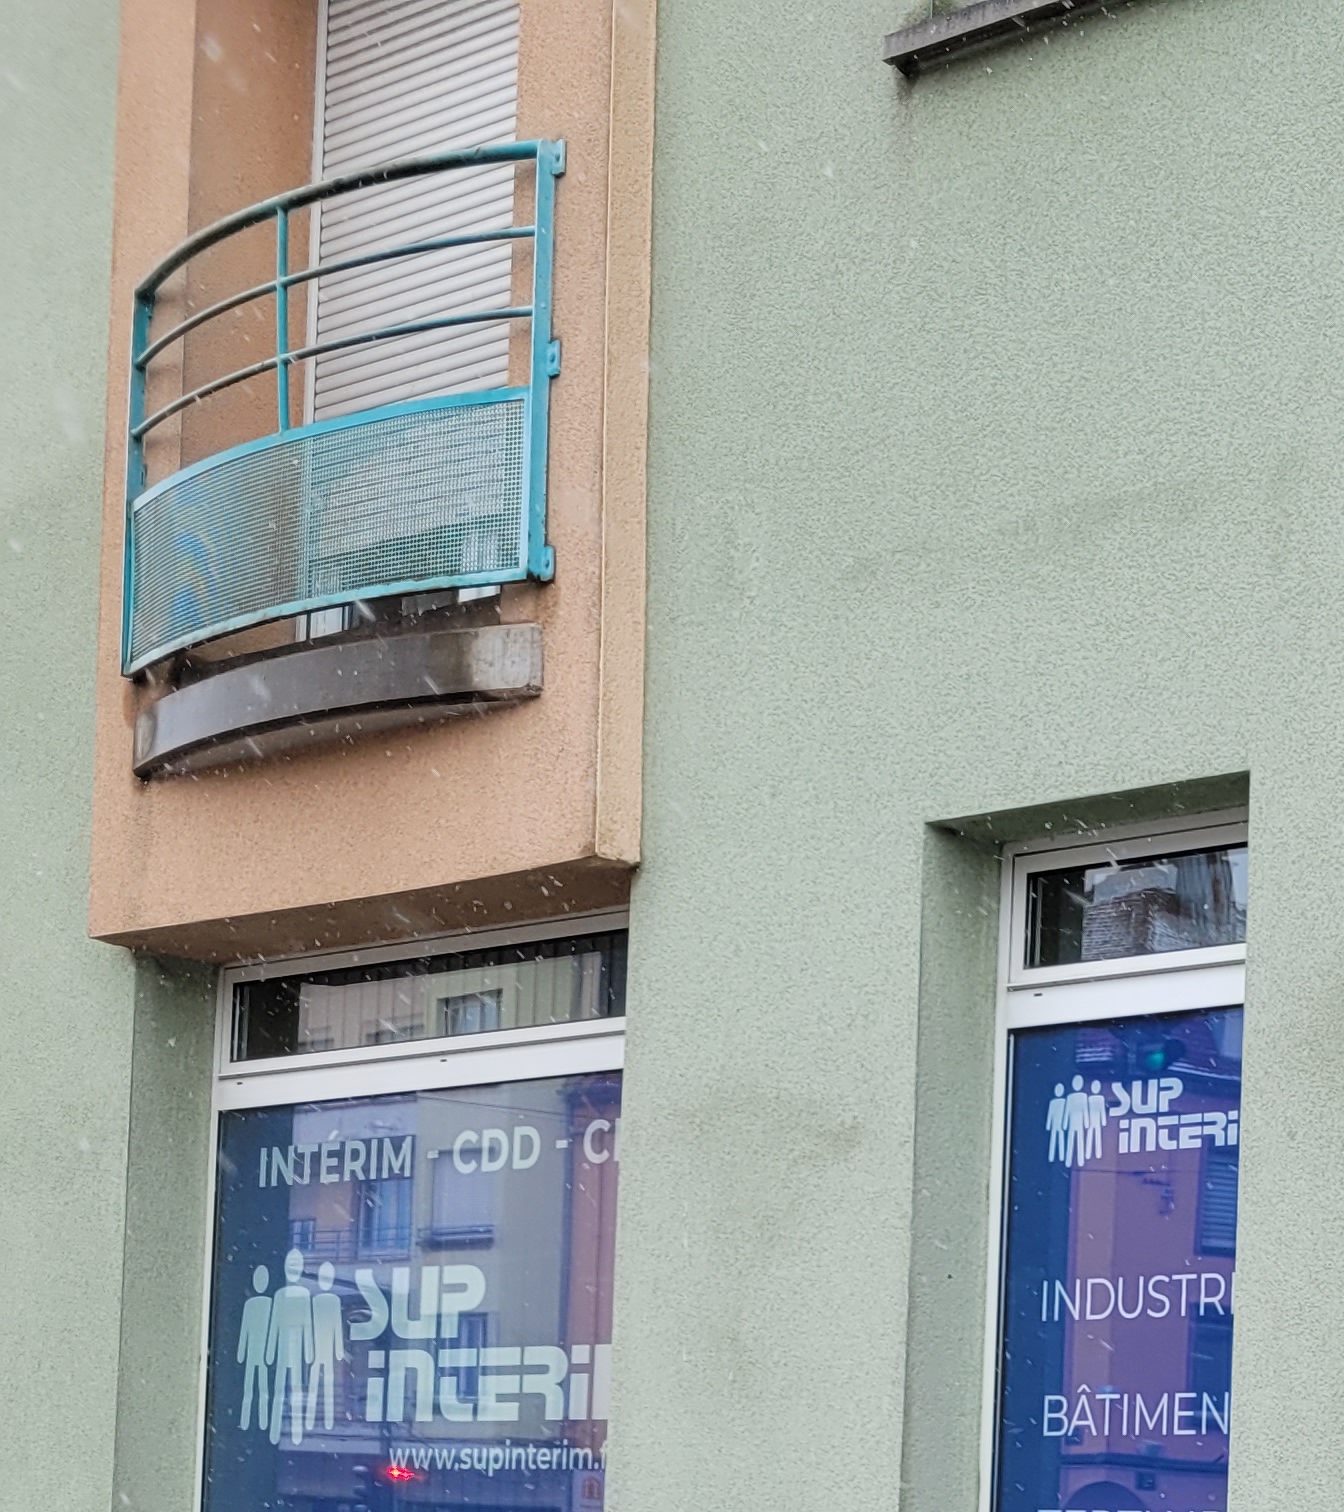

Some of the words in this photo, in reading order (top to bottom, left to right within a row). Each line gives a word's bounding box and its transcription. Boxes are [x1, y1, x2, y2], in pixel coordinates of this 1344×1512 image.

[1109, 1077, 1184, 1117] SUP
[258, 1129, 414, 1188] INTÉRIM
[452, 1126, 541, 1174] CDD
[583, 1118, 620, 1164] C
[349, 1264, 487, 1341] SUP
[1042, 1383, 1230, 1437] BÂTIMEN
